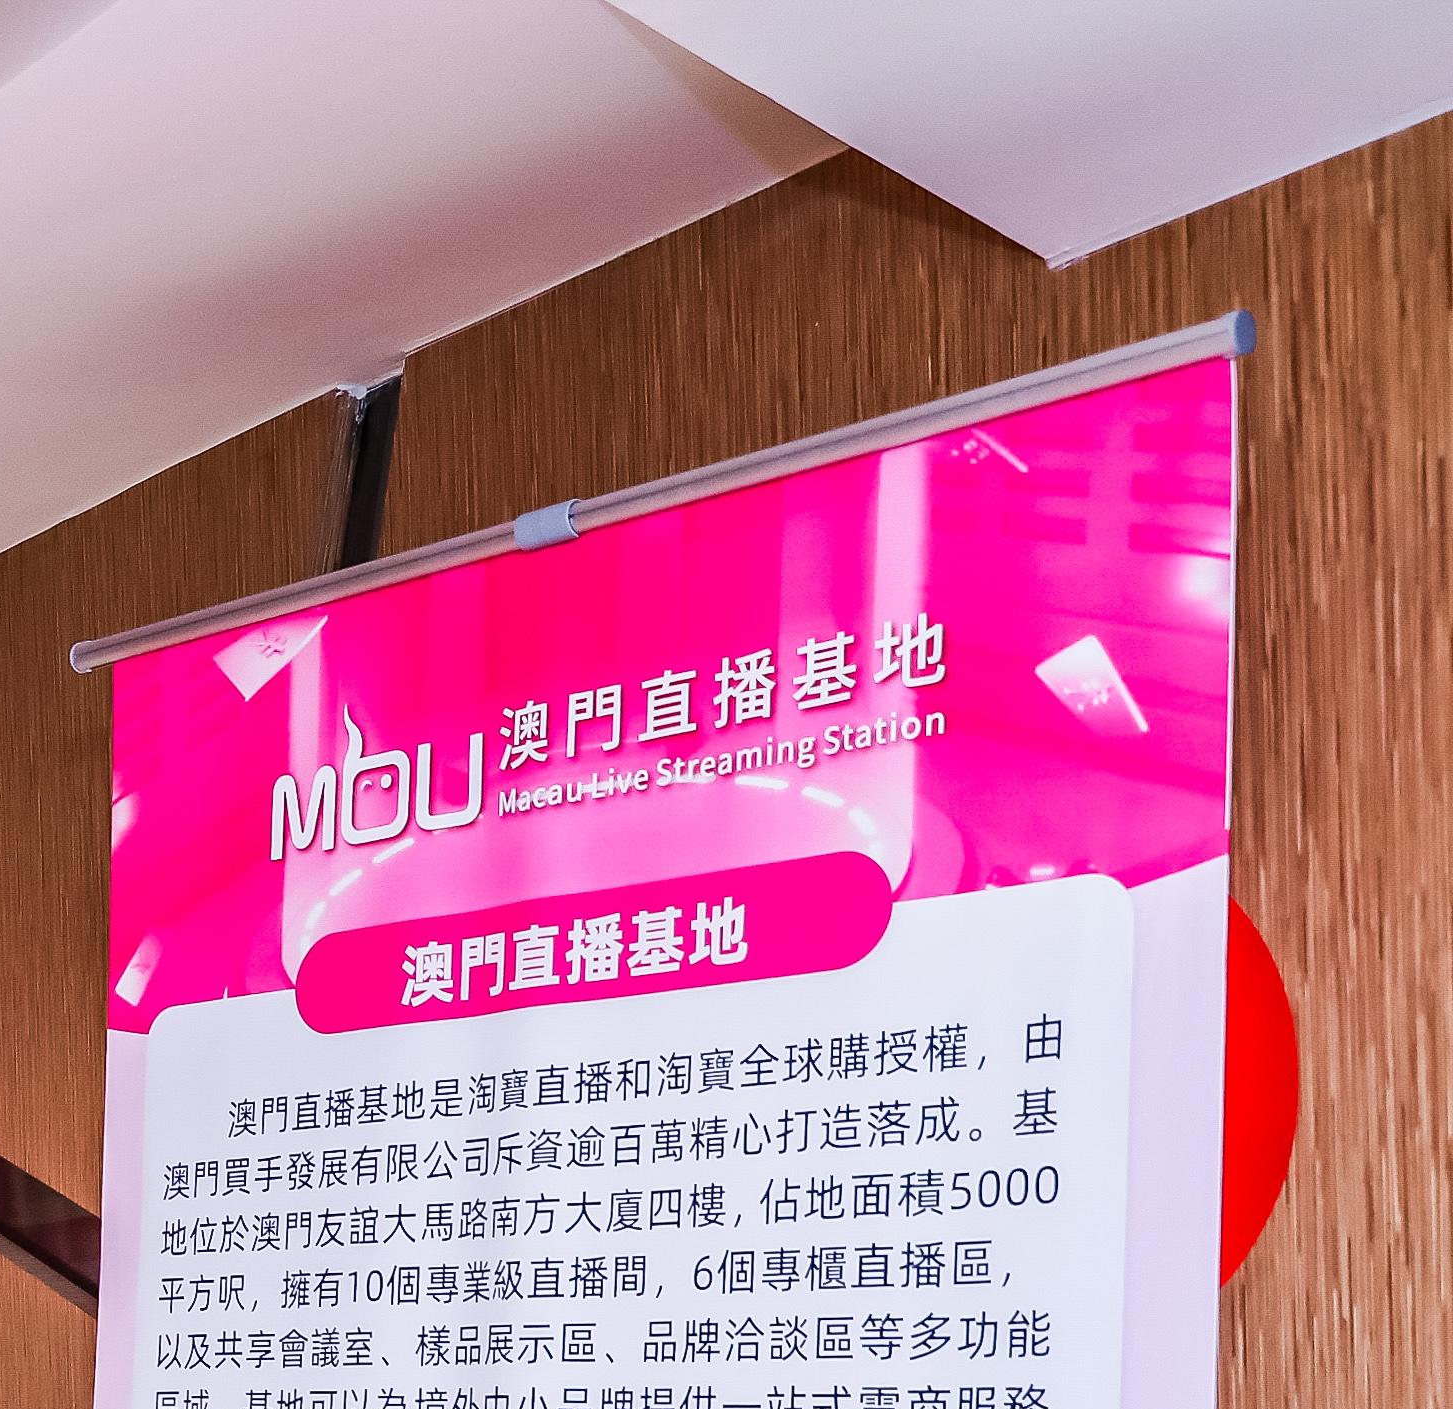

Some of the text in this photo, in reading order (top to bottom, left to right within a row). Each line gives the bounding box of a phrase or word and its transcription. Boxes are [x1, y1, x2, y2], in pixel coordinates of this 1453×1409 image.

[498, 612, 946, 771] 澳門直播基地
[498, 710, 946, 817] Macau Live Streaming Station
[401, 897, 748, 1007] 澳門直播基地
